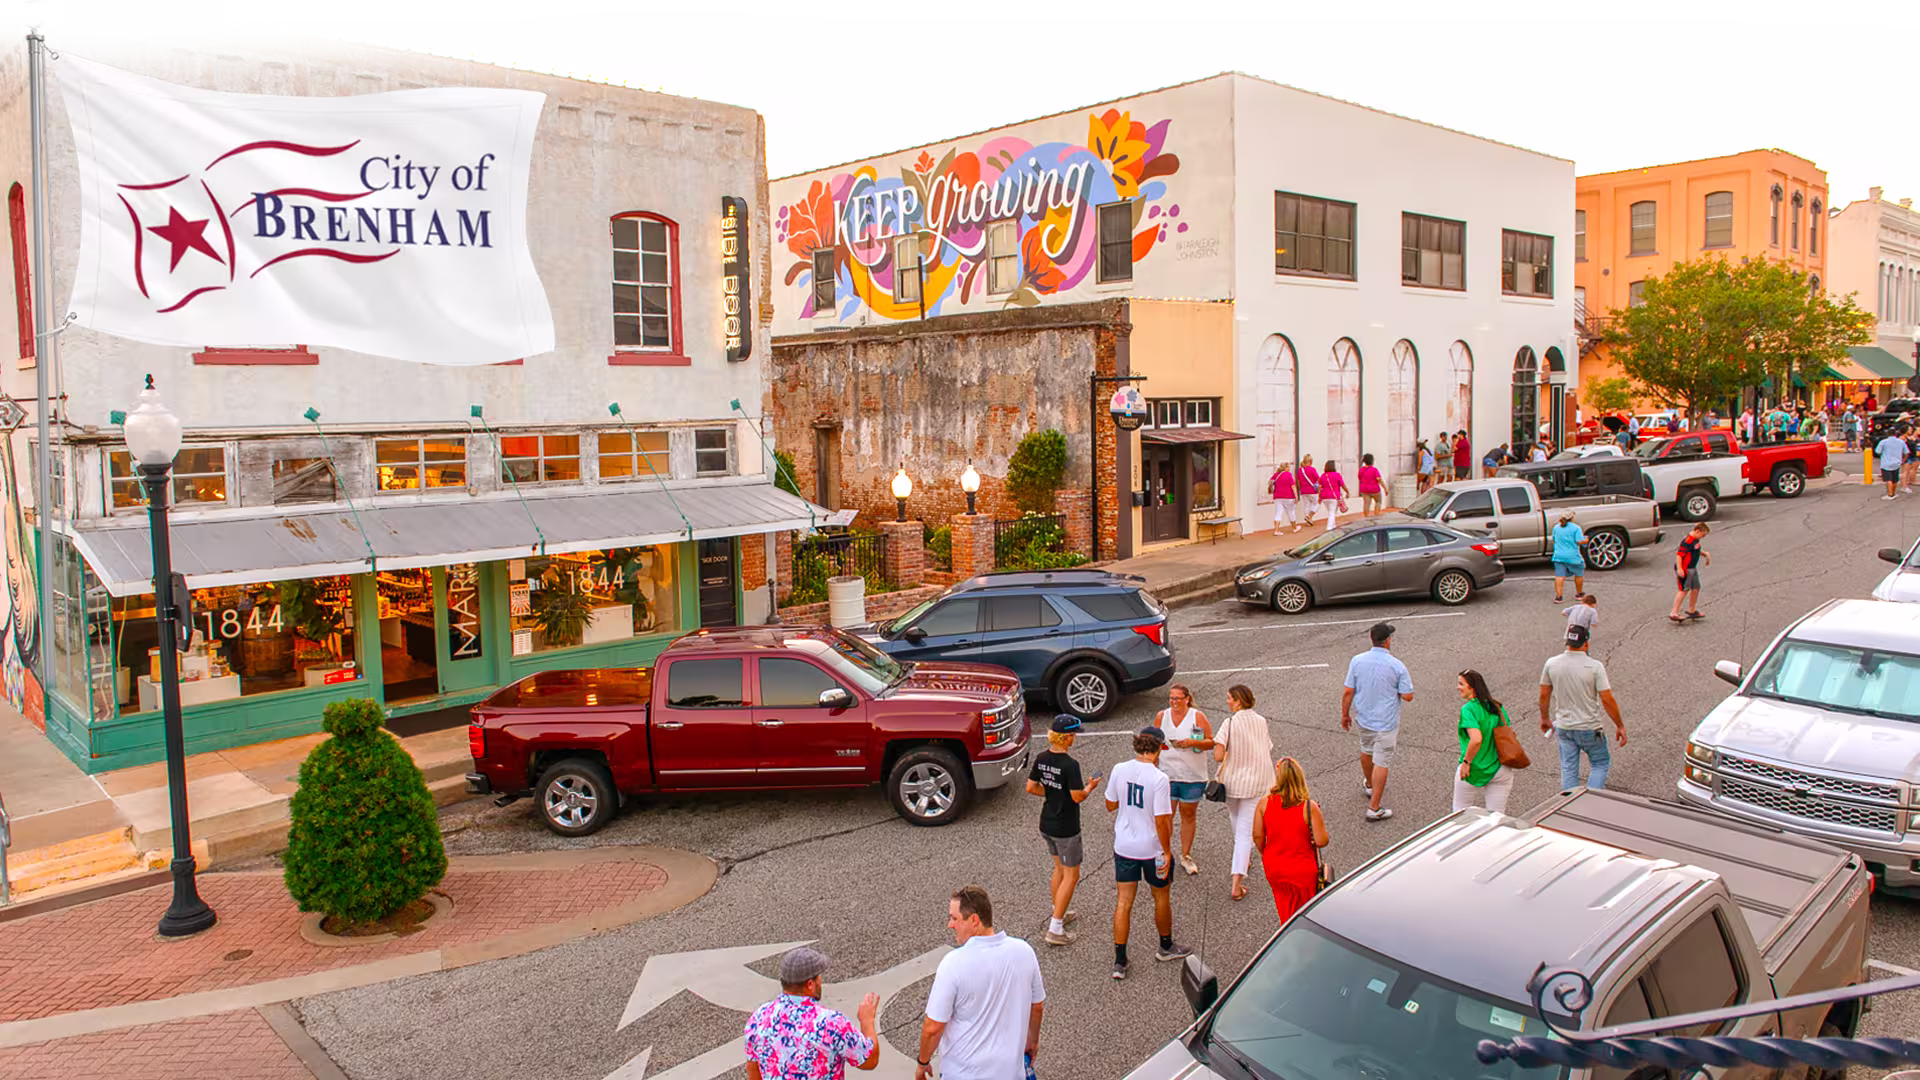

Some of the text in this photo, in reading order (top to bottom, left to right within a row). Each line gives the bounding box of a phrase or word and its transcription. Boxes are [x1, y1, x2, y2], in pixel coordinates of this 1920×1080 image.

[360, 153, 495, 200] City of
[833, 157, 1091, 266] KEEP growing
[722, 217, 738, 265] SIDE
[723, 275, 742, 351] DOOR
[566, 566, 625, 595] 1844
[201, 604, 284, 641] 1844
[1127, 781, 1144, 809] 10
